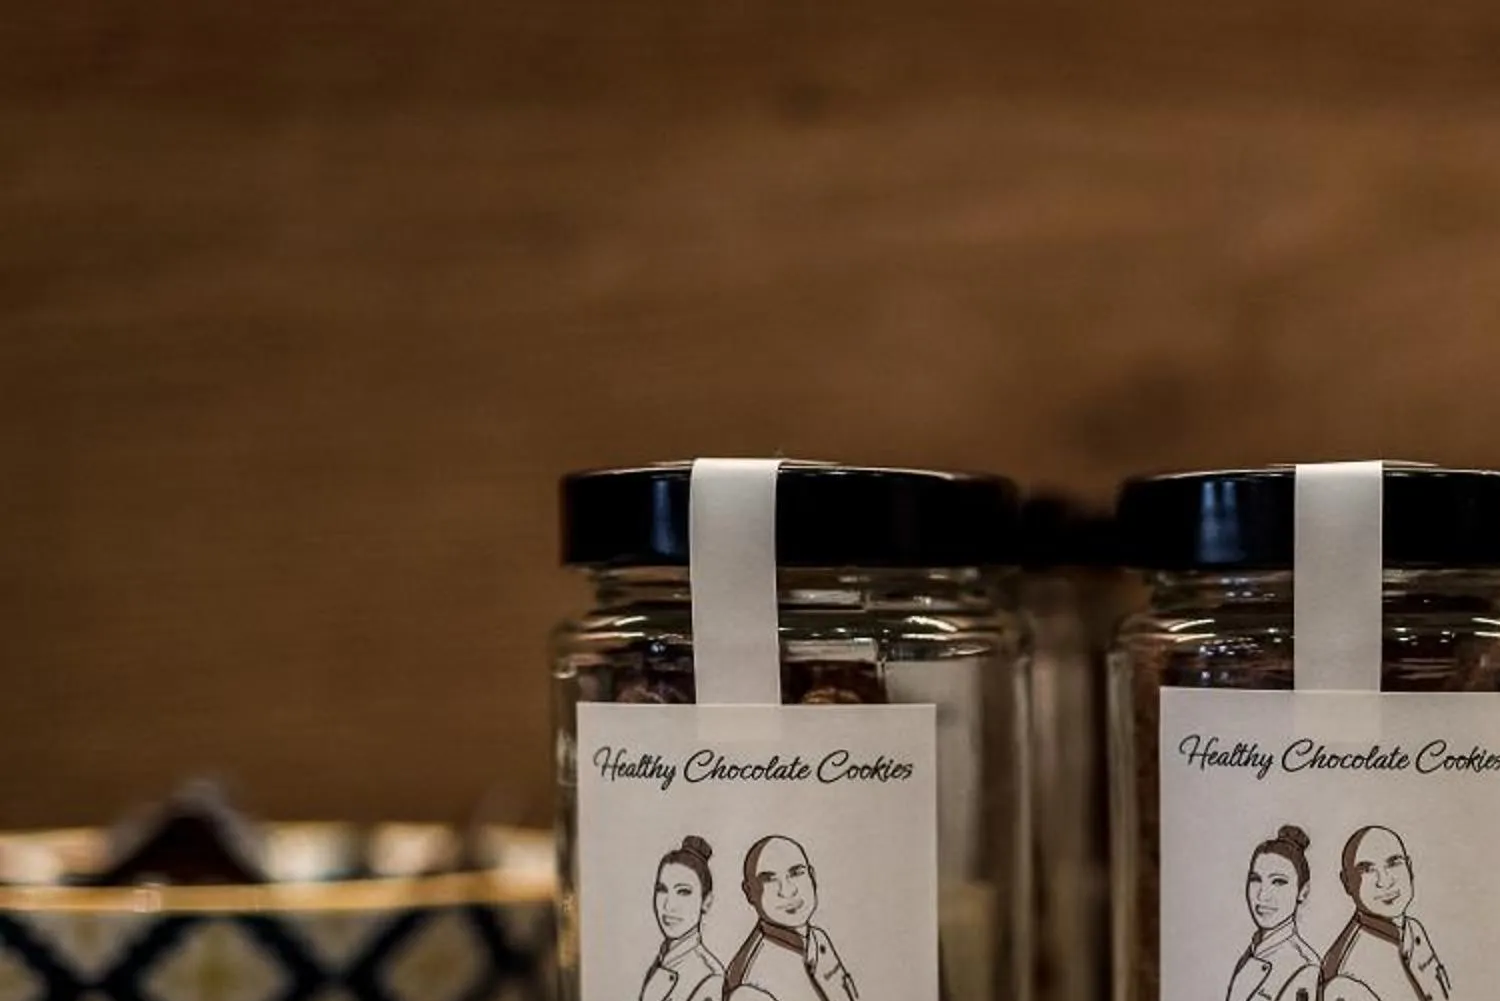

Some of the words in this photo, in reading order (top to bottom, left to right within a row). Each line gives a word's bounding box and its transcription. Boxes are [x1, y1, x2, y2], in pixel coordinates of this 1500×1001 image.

[593, 746, 677, 791] Healthy
[684, 749, 812, 784] Chocolate
[817, 749, 914, 784] Cookies
[1178, 734, 1273, 780] Healthy
[1281, 738, 1410, 774] Chocolate
